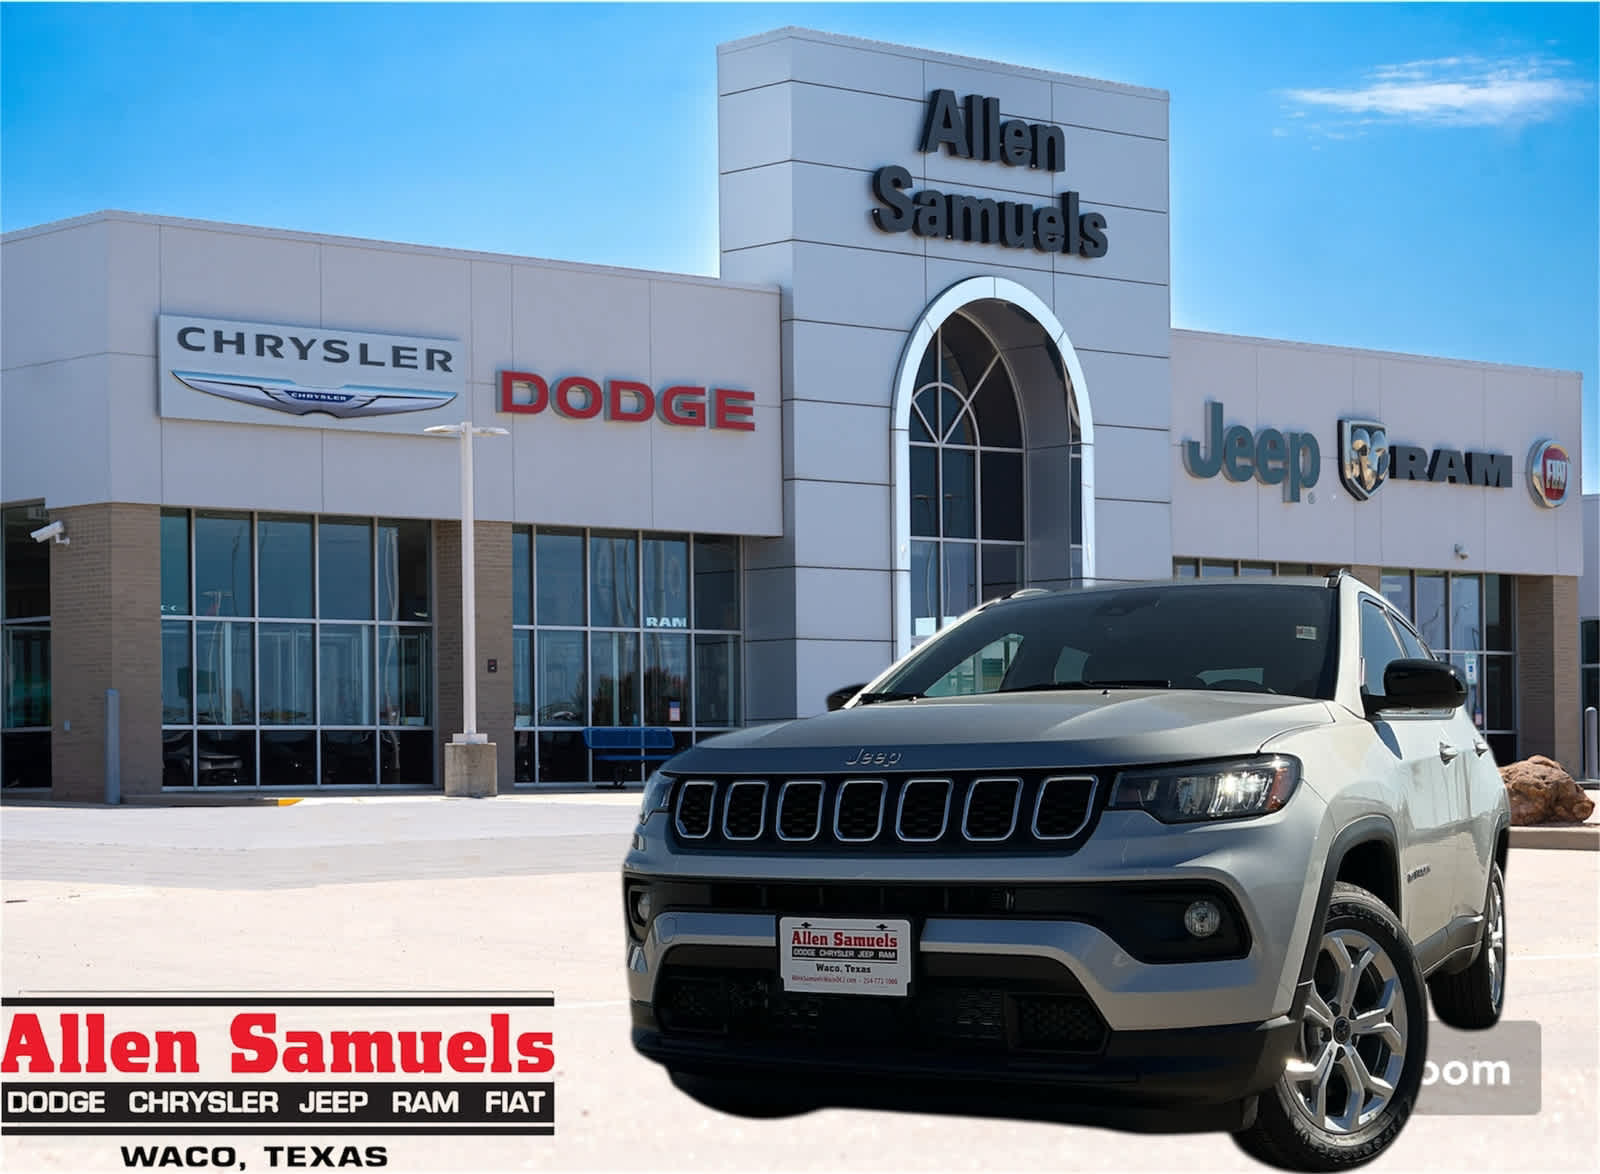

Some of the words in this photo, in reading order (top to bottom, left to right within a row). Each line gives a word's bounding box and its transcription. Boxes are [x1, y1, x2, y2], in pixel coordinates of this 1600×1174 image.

[918, 88, 1066, 172] Allen
[872, 165, 1108, 258] Samuels
[177, 326, 453, 373] CHRYSLER
[290, 390, 349, 402] CHRYSLER
[496, 370, 756, 432] DODGE
[1182, 400, 1321, 503] Jeep
[1389, 444, 1513, 489] RAM
[645, 616, 687, 628] RAM
[845, 747, 902, 767] Jeep
[792, 930, 828, 946] Allen
[833, 931, 898, 948] Samuels
[793, 948, 817, 957] DODGE
[819, 949, 855, 958] CHRYSLER
[857, 950, 875, 959] JEEP
[878, 951, 896, 959] RAM
[845, 964, 872, 974] Texas
